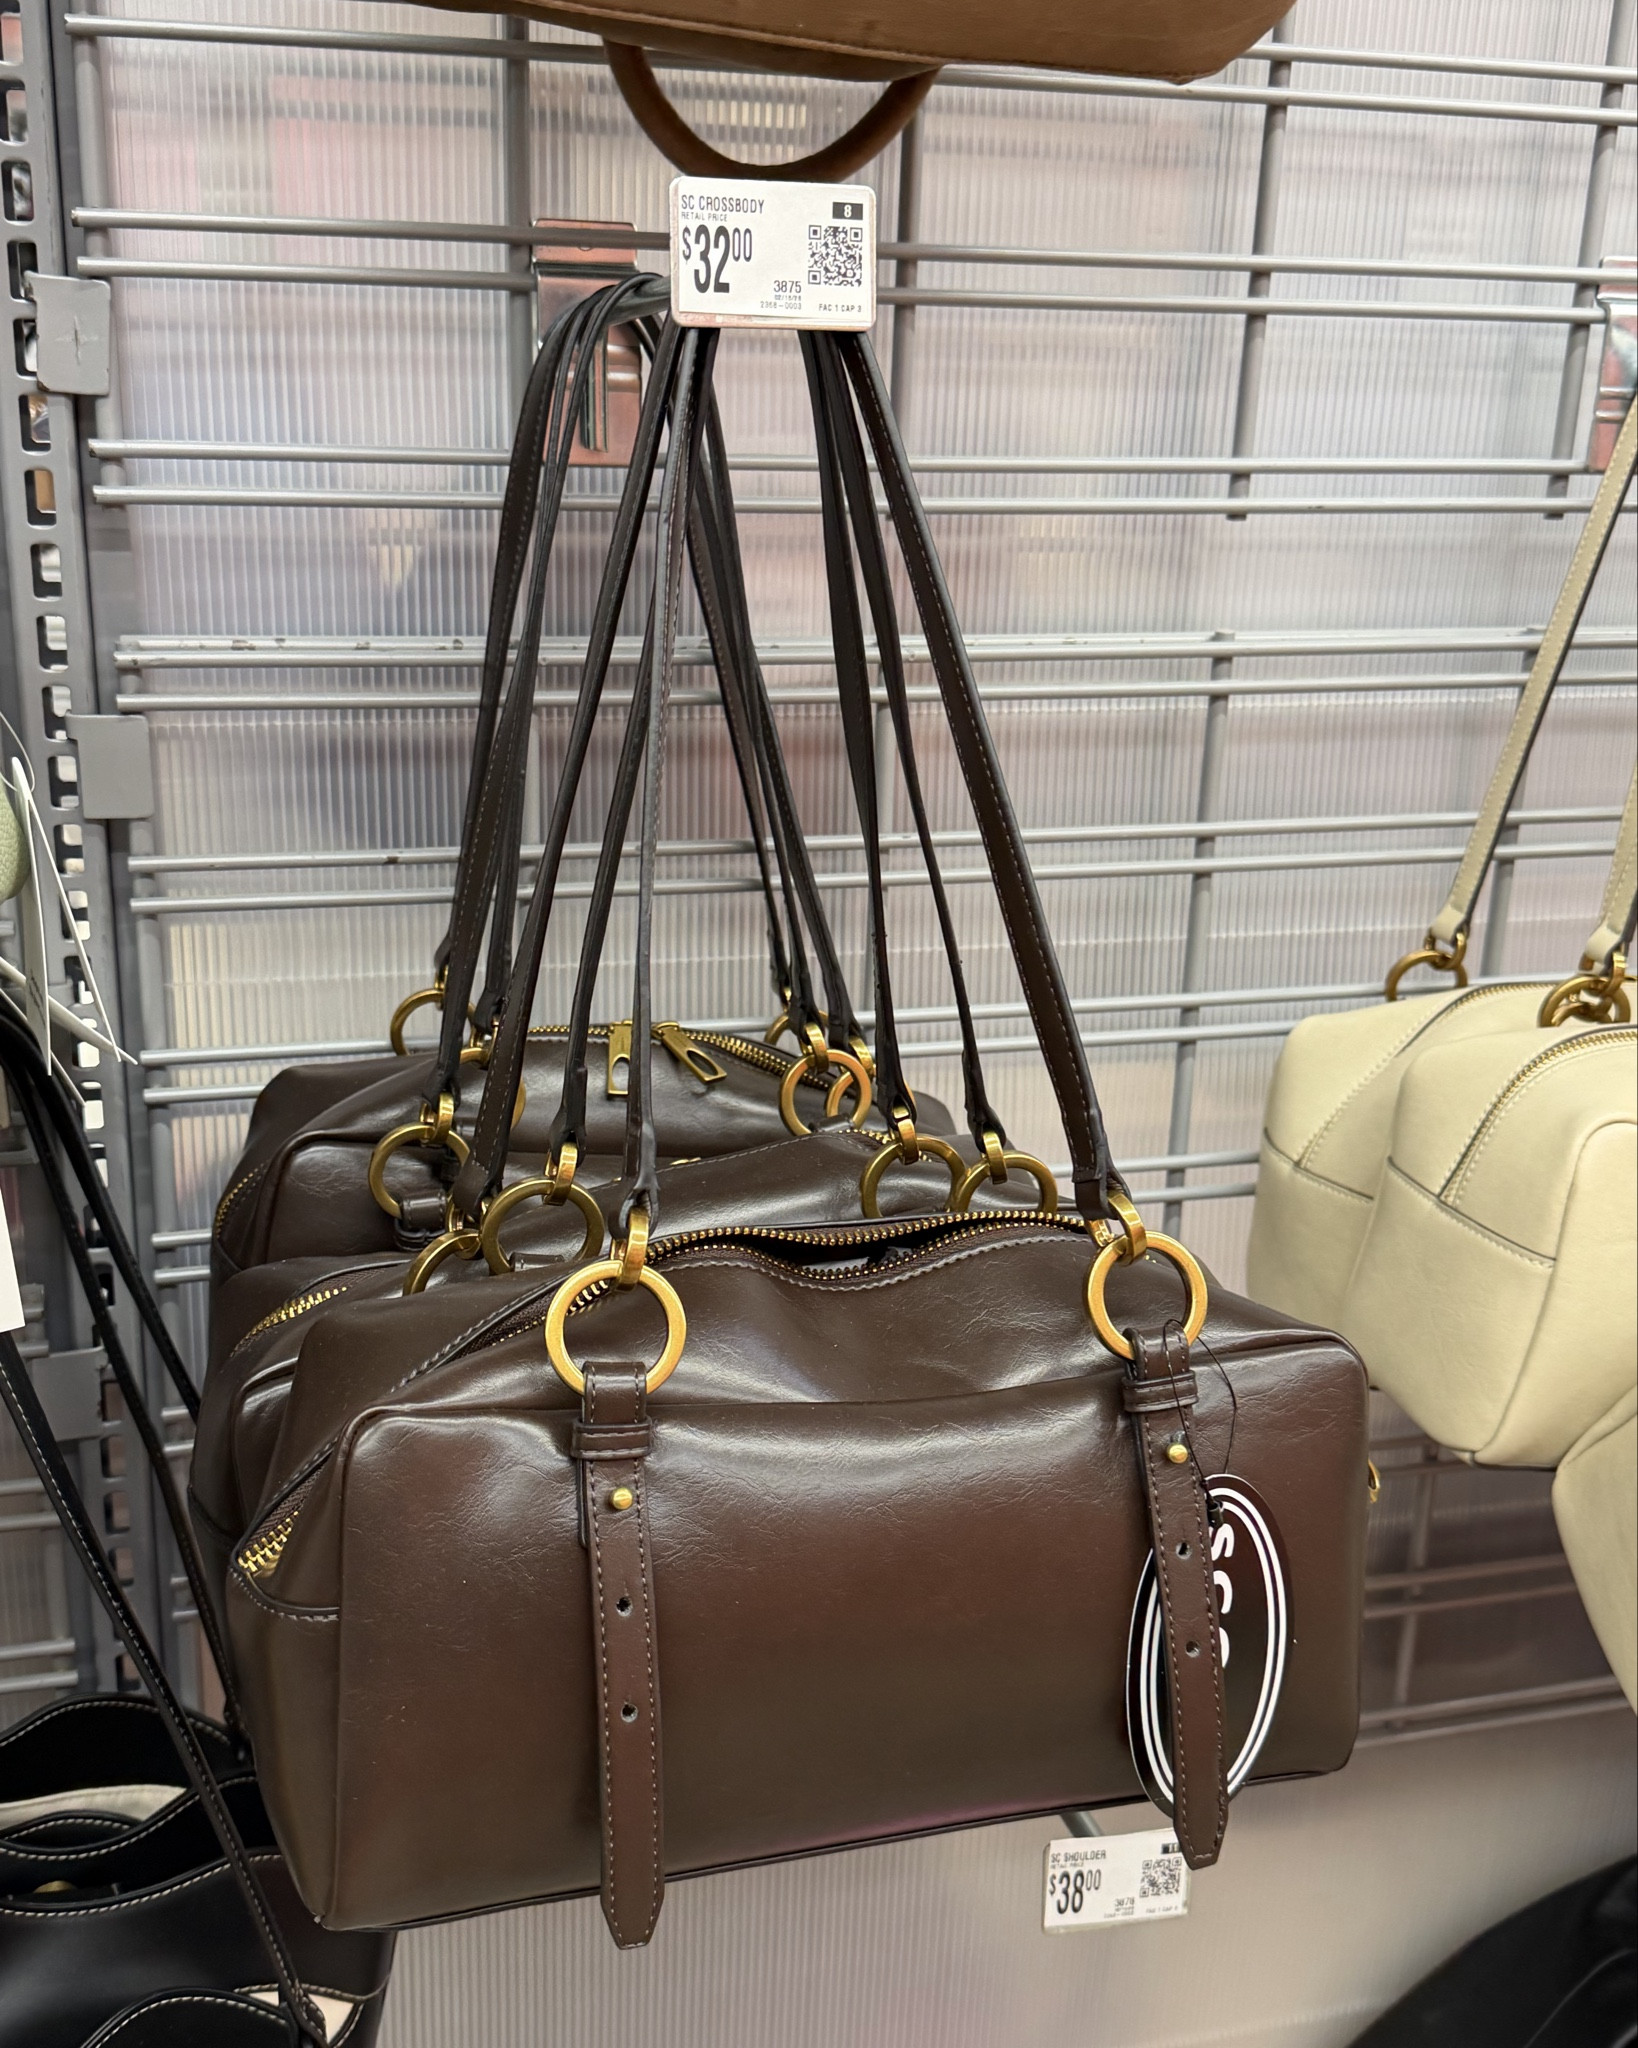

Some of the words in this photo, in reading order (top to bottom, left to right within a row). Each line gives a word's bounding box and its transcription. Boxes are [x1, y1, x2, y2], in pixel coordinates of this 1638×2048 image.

[681, 194, 695, 210] SC
[698, 195, 765, 214] CROSSBODY
[681, 212, 705, 221] RETAIL
[708, 213, 728, 222] PRICE
[844, 204, 853, 218] 8
[773, 280, 802, 293] 3875
[818, 304, 833, 312] FAC
[841, 304, 856, 312] CAP
[1064, 1849, 1107, 1862] SHOULDER
